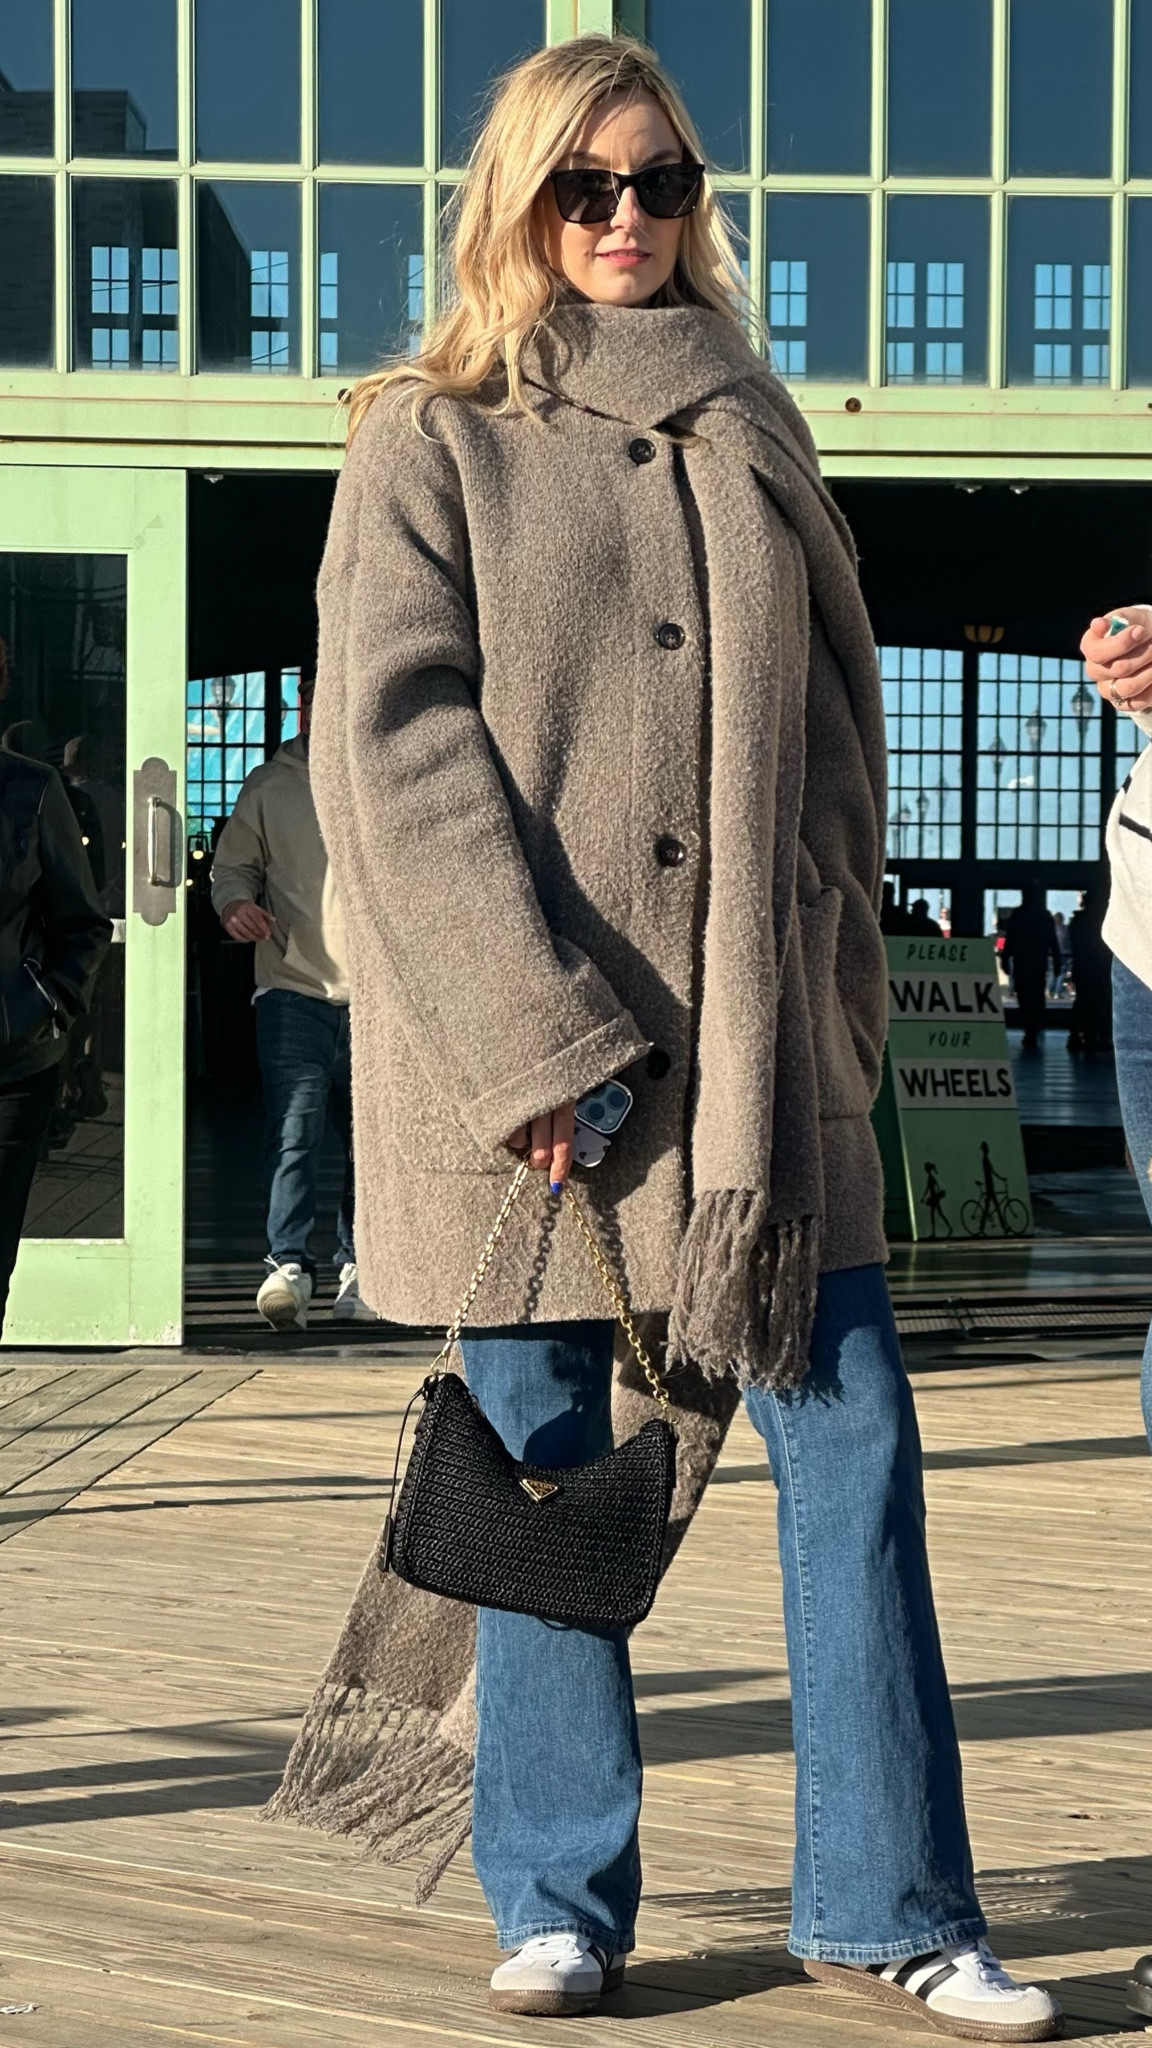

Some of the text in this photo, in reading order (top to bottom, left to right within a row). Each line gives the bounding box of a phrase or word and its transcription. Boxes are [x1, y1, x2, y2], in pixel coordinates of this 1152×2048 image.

[907, 944, 968, 961] PLEASE
[889, 980, 999, 1013] WALK
[928, 1031, 970, 1047] YOUR
[899, 1068, 1011, 1097] WHEELS
